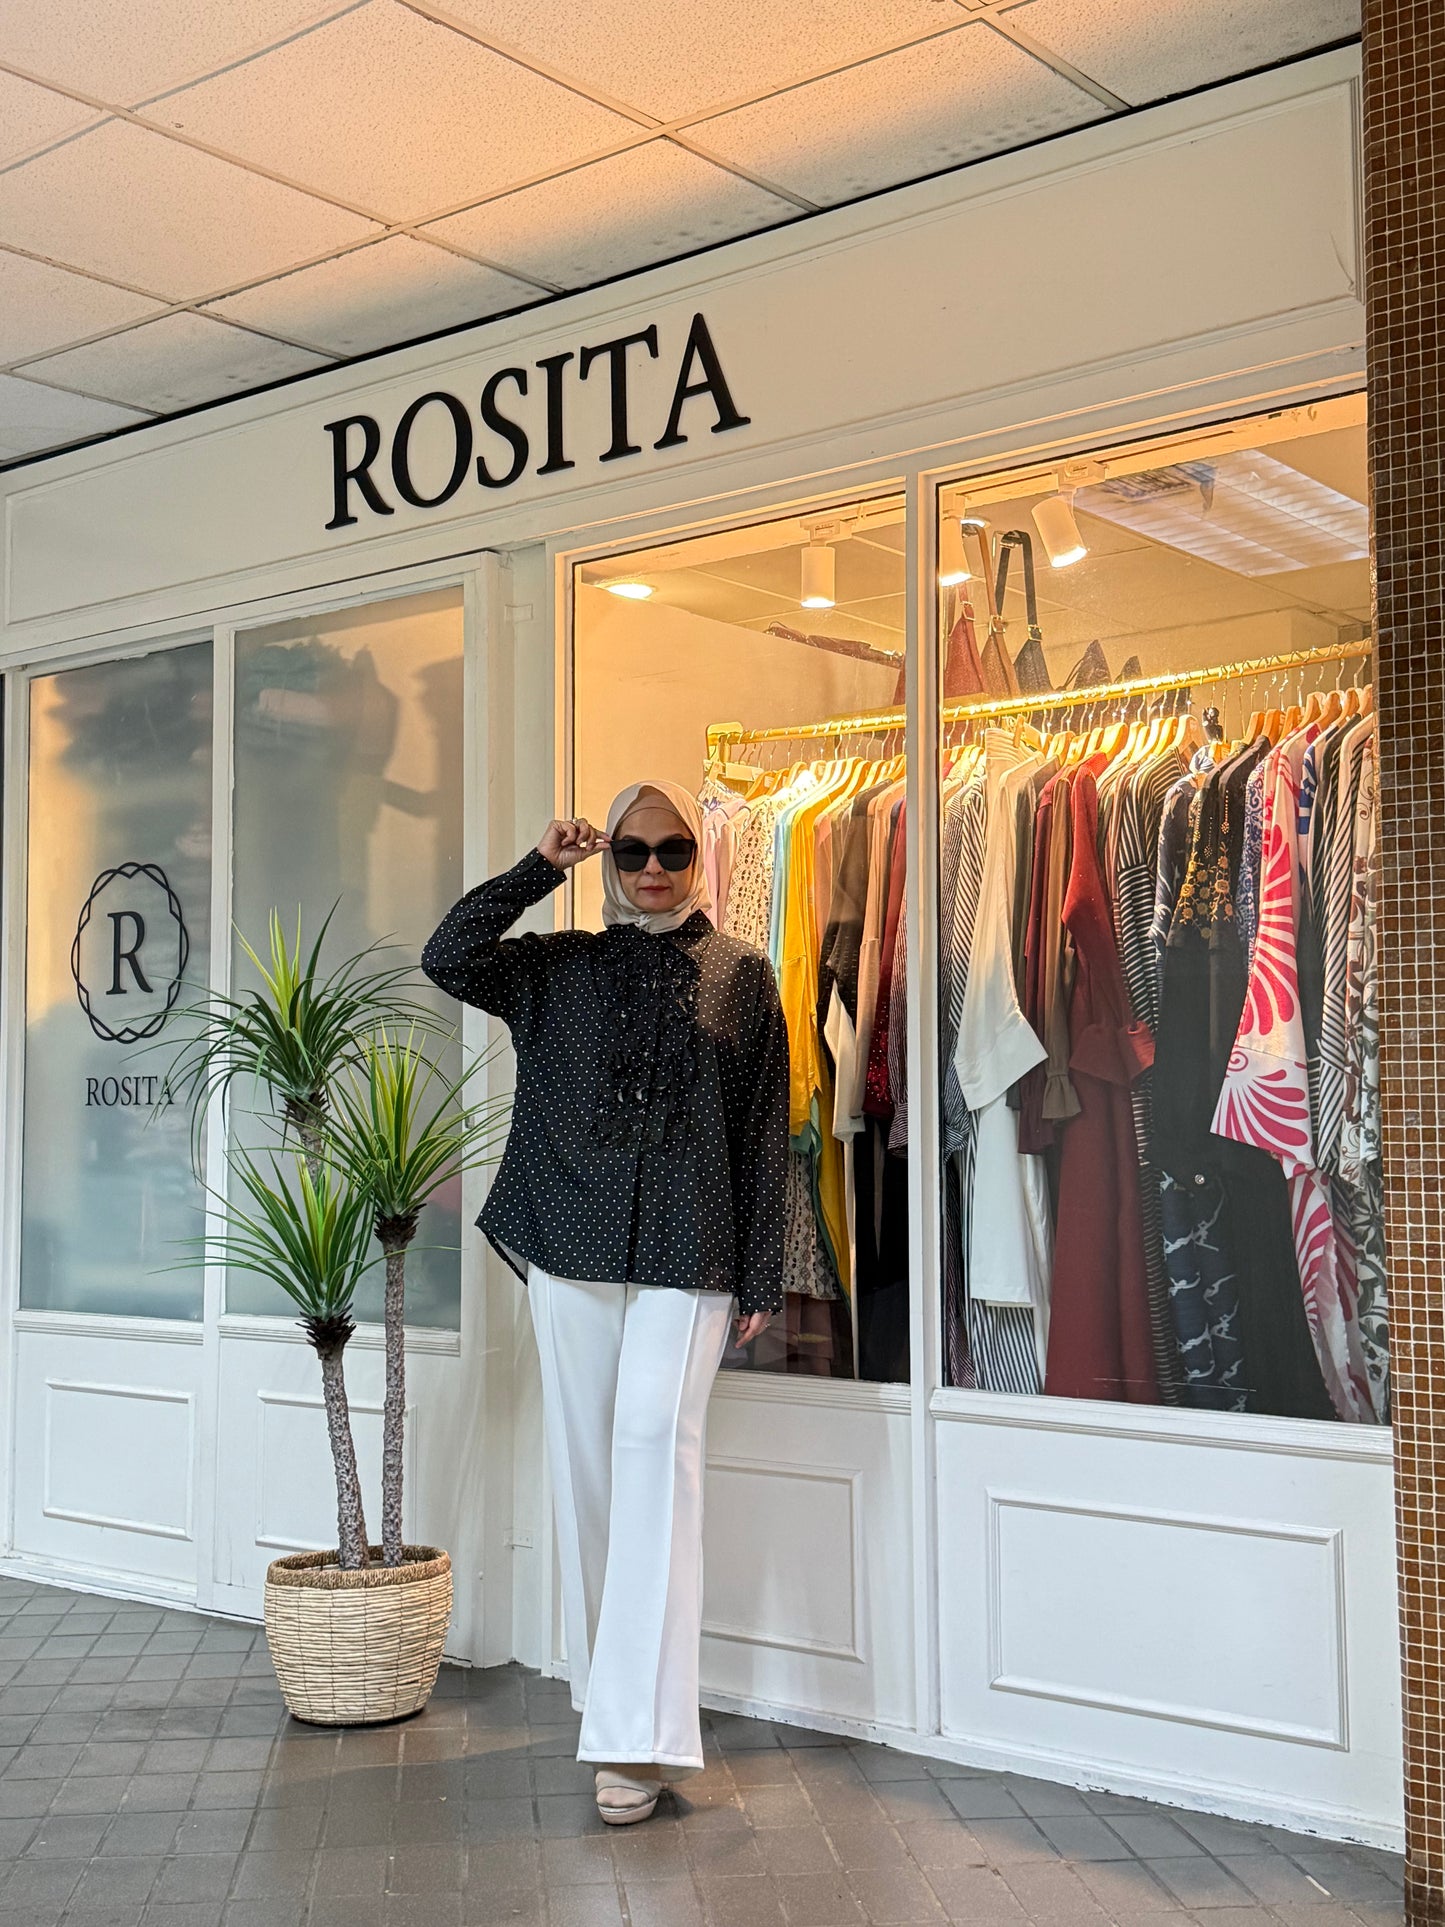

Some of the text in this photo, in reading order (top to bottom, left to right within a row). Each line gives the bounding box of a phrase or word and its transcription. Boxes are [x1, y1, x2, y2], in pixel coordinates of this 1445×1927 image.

[324, 312, 751, 531] ROSITA
[106, 910, 154, 995] R
[85, 1075, 174, 1106] ROSITA
